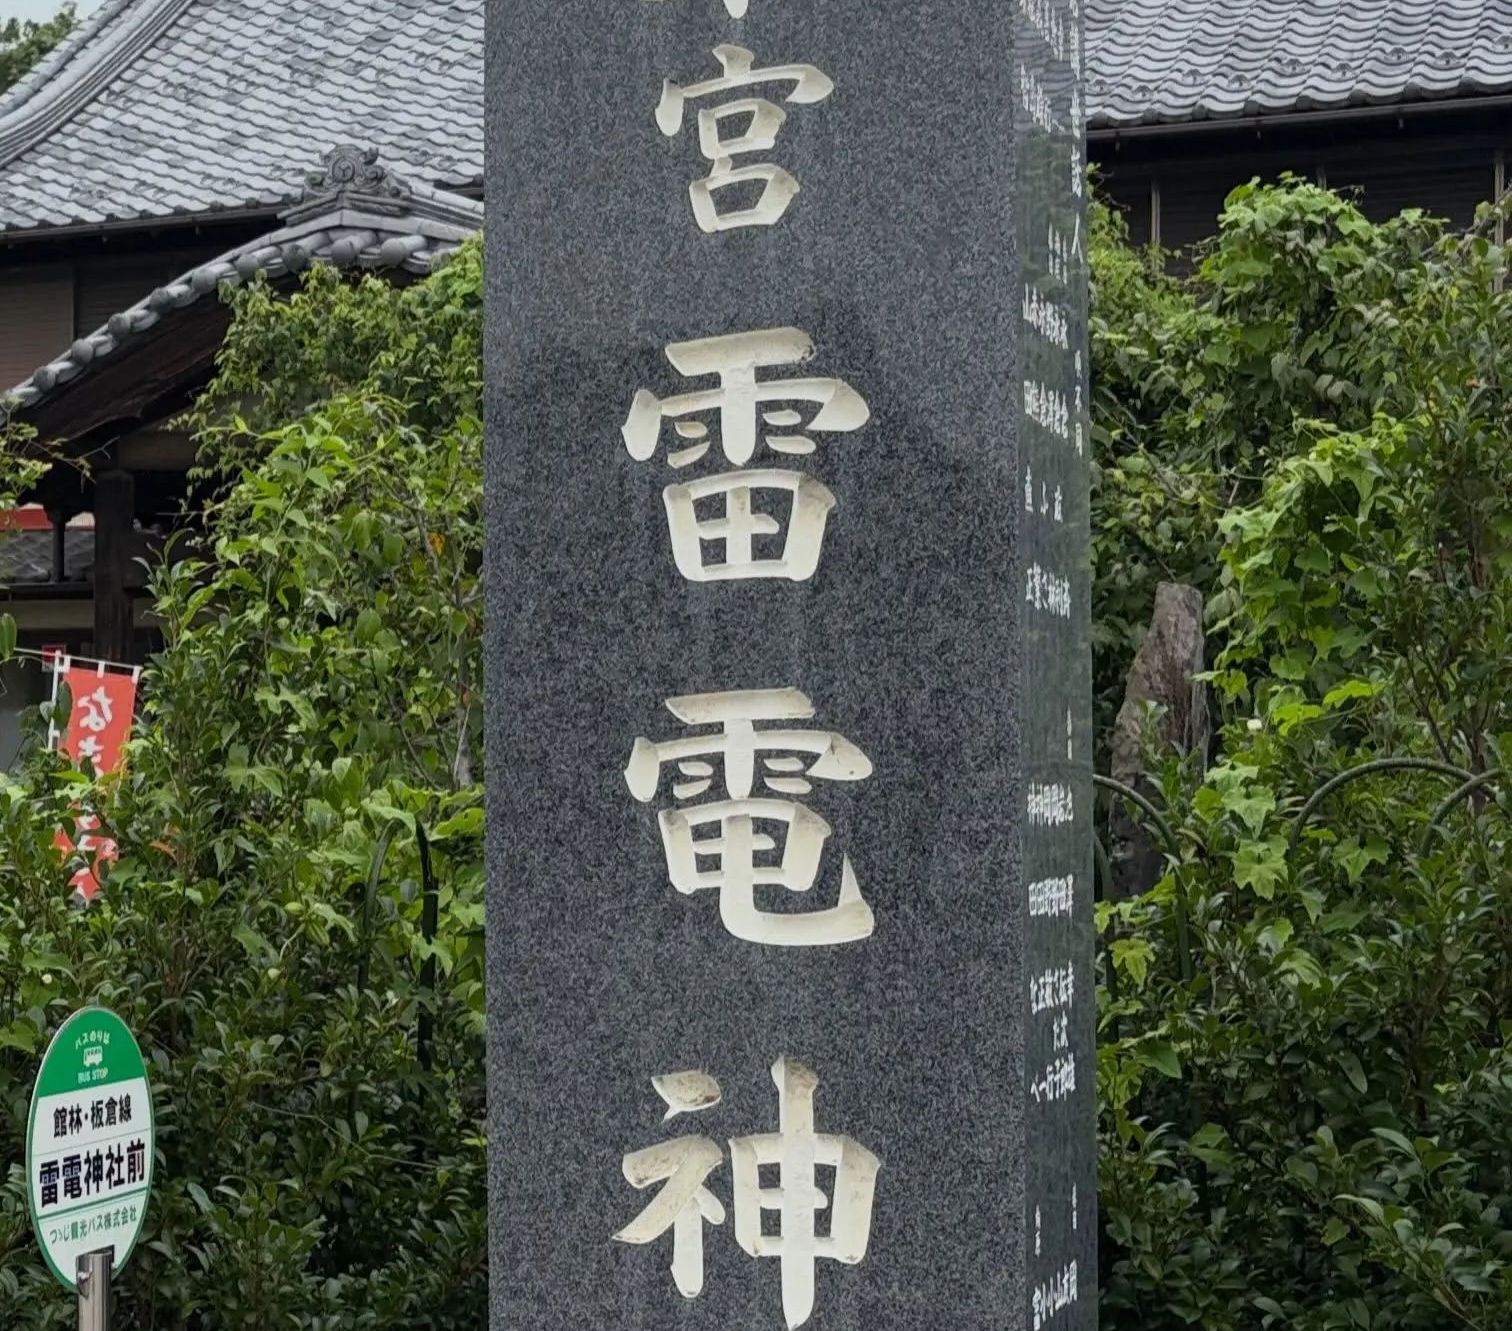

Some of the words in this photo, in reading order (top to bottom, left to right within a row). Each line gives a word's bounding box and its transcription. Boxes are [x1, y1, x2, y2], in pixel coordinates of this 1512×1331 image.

[75, 1029, 110, 1051] バスのりば
[77, 1072, 91, 1084] BUS
[91, 1067, 109, 1081] STOP
[53, 1093, 132, 1139] 館林・板倉線
[39, 1138, 145, 1208] 雷電神社前
